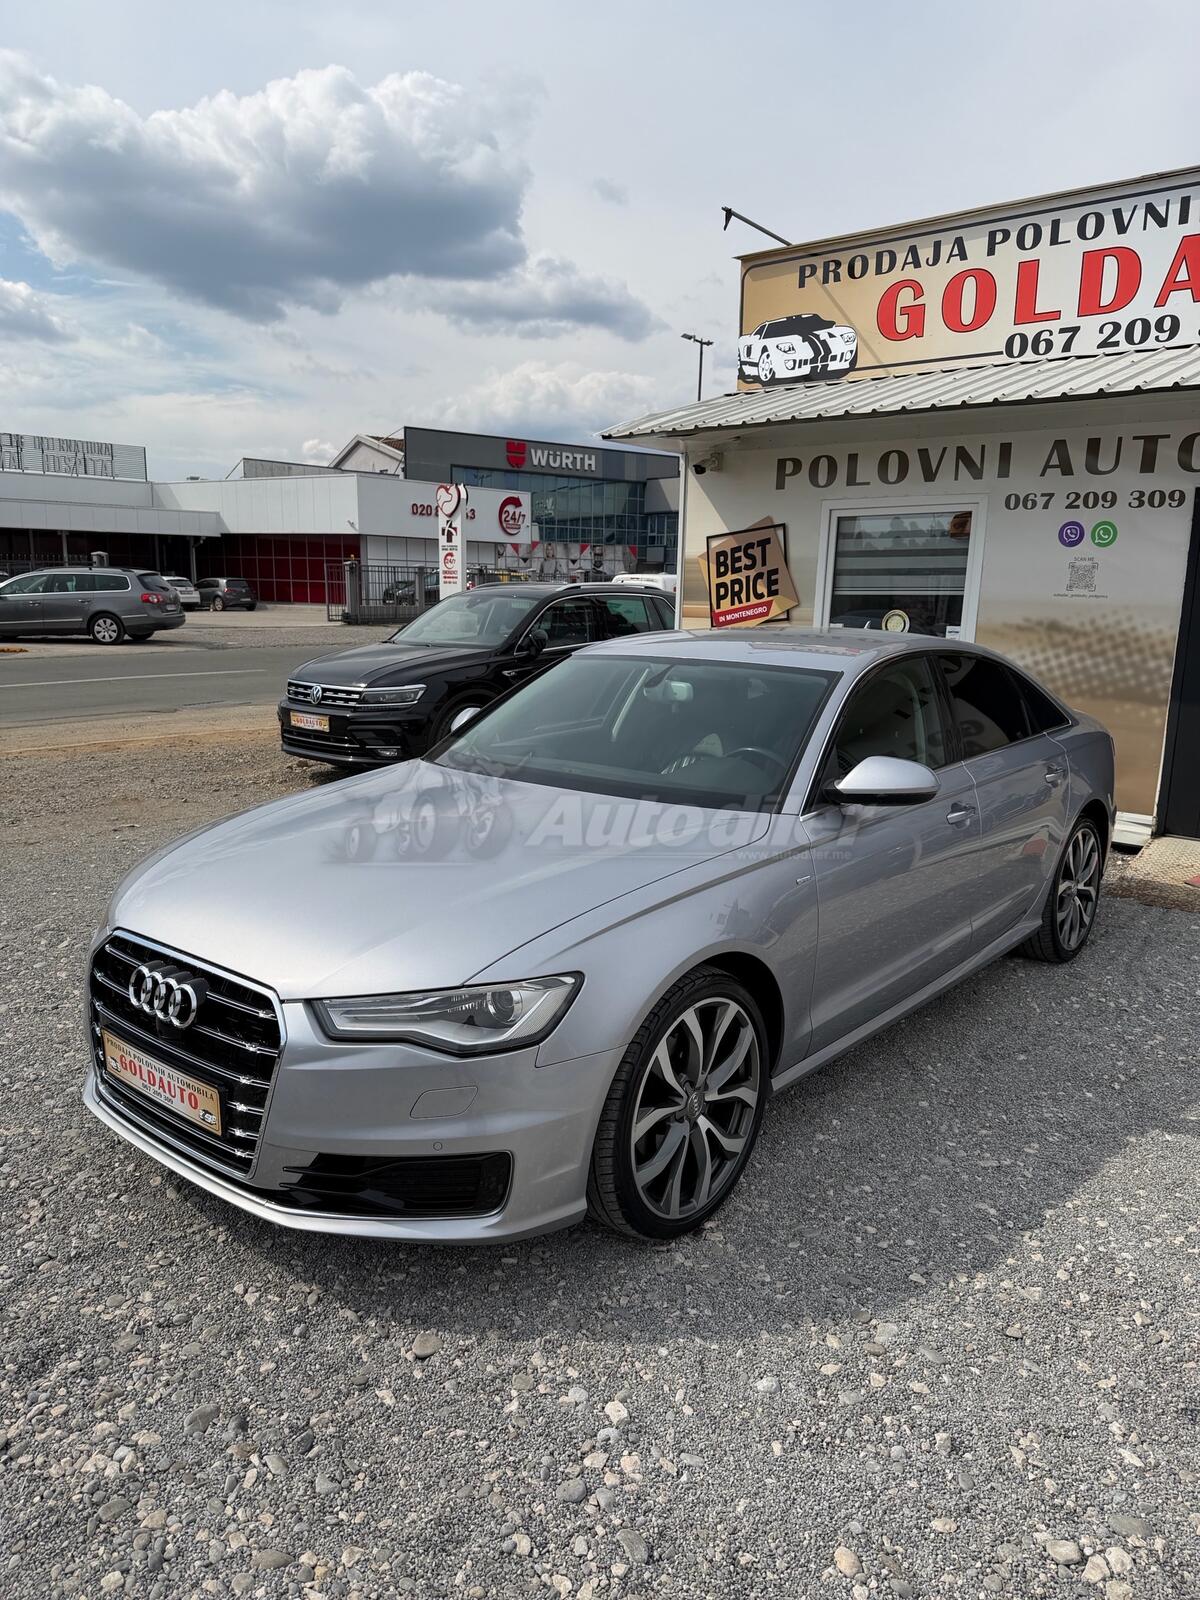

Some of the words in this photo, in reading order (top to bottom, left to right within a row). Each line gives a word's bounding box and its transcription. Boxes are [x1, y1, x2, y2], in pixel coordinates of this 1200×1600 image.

[798, 236, 969, 289] PRODAJA
[986, 195, 1192, 257] POLOVNI
[876, 233, 1200, 342] GOLDA
[1004, 326, 1081, 359] 067
[1096, 314, 1181, 349] 209
[530, 448, 596, 471] WÜRTH
[775, 441, 1013, 490] POLOVNI
[1039, 431, 1200, 477] AUTO
[411, 503, 433, 517] 020
[503, 510, 526, 524] 24/7
[1004, 492, 1055, 511] 067
[1065, 490, 1118, 510] 209
[1128, 489, 1187, 509] 309
[715, 537, 771, 579] BEST
[715, 568, 779, 610] PRICE
[726, 606, 768, 621] MONTENEGRO
[106, 1037, 132, 1059] PRODAJA
[132, 1053, 166, 1077] POLOVNIH
[167, 1073, 214, 1102] AUTOMOBILA
[119, 1054, 199, 1110] GOLDAUTO
